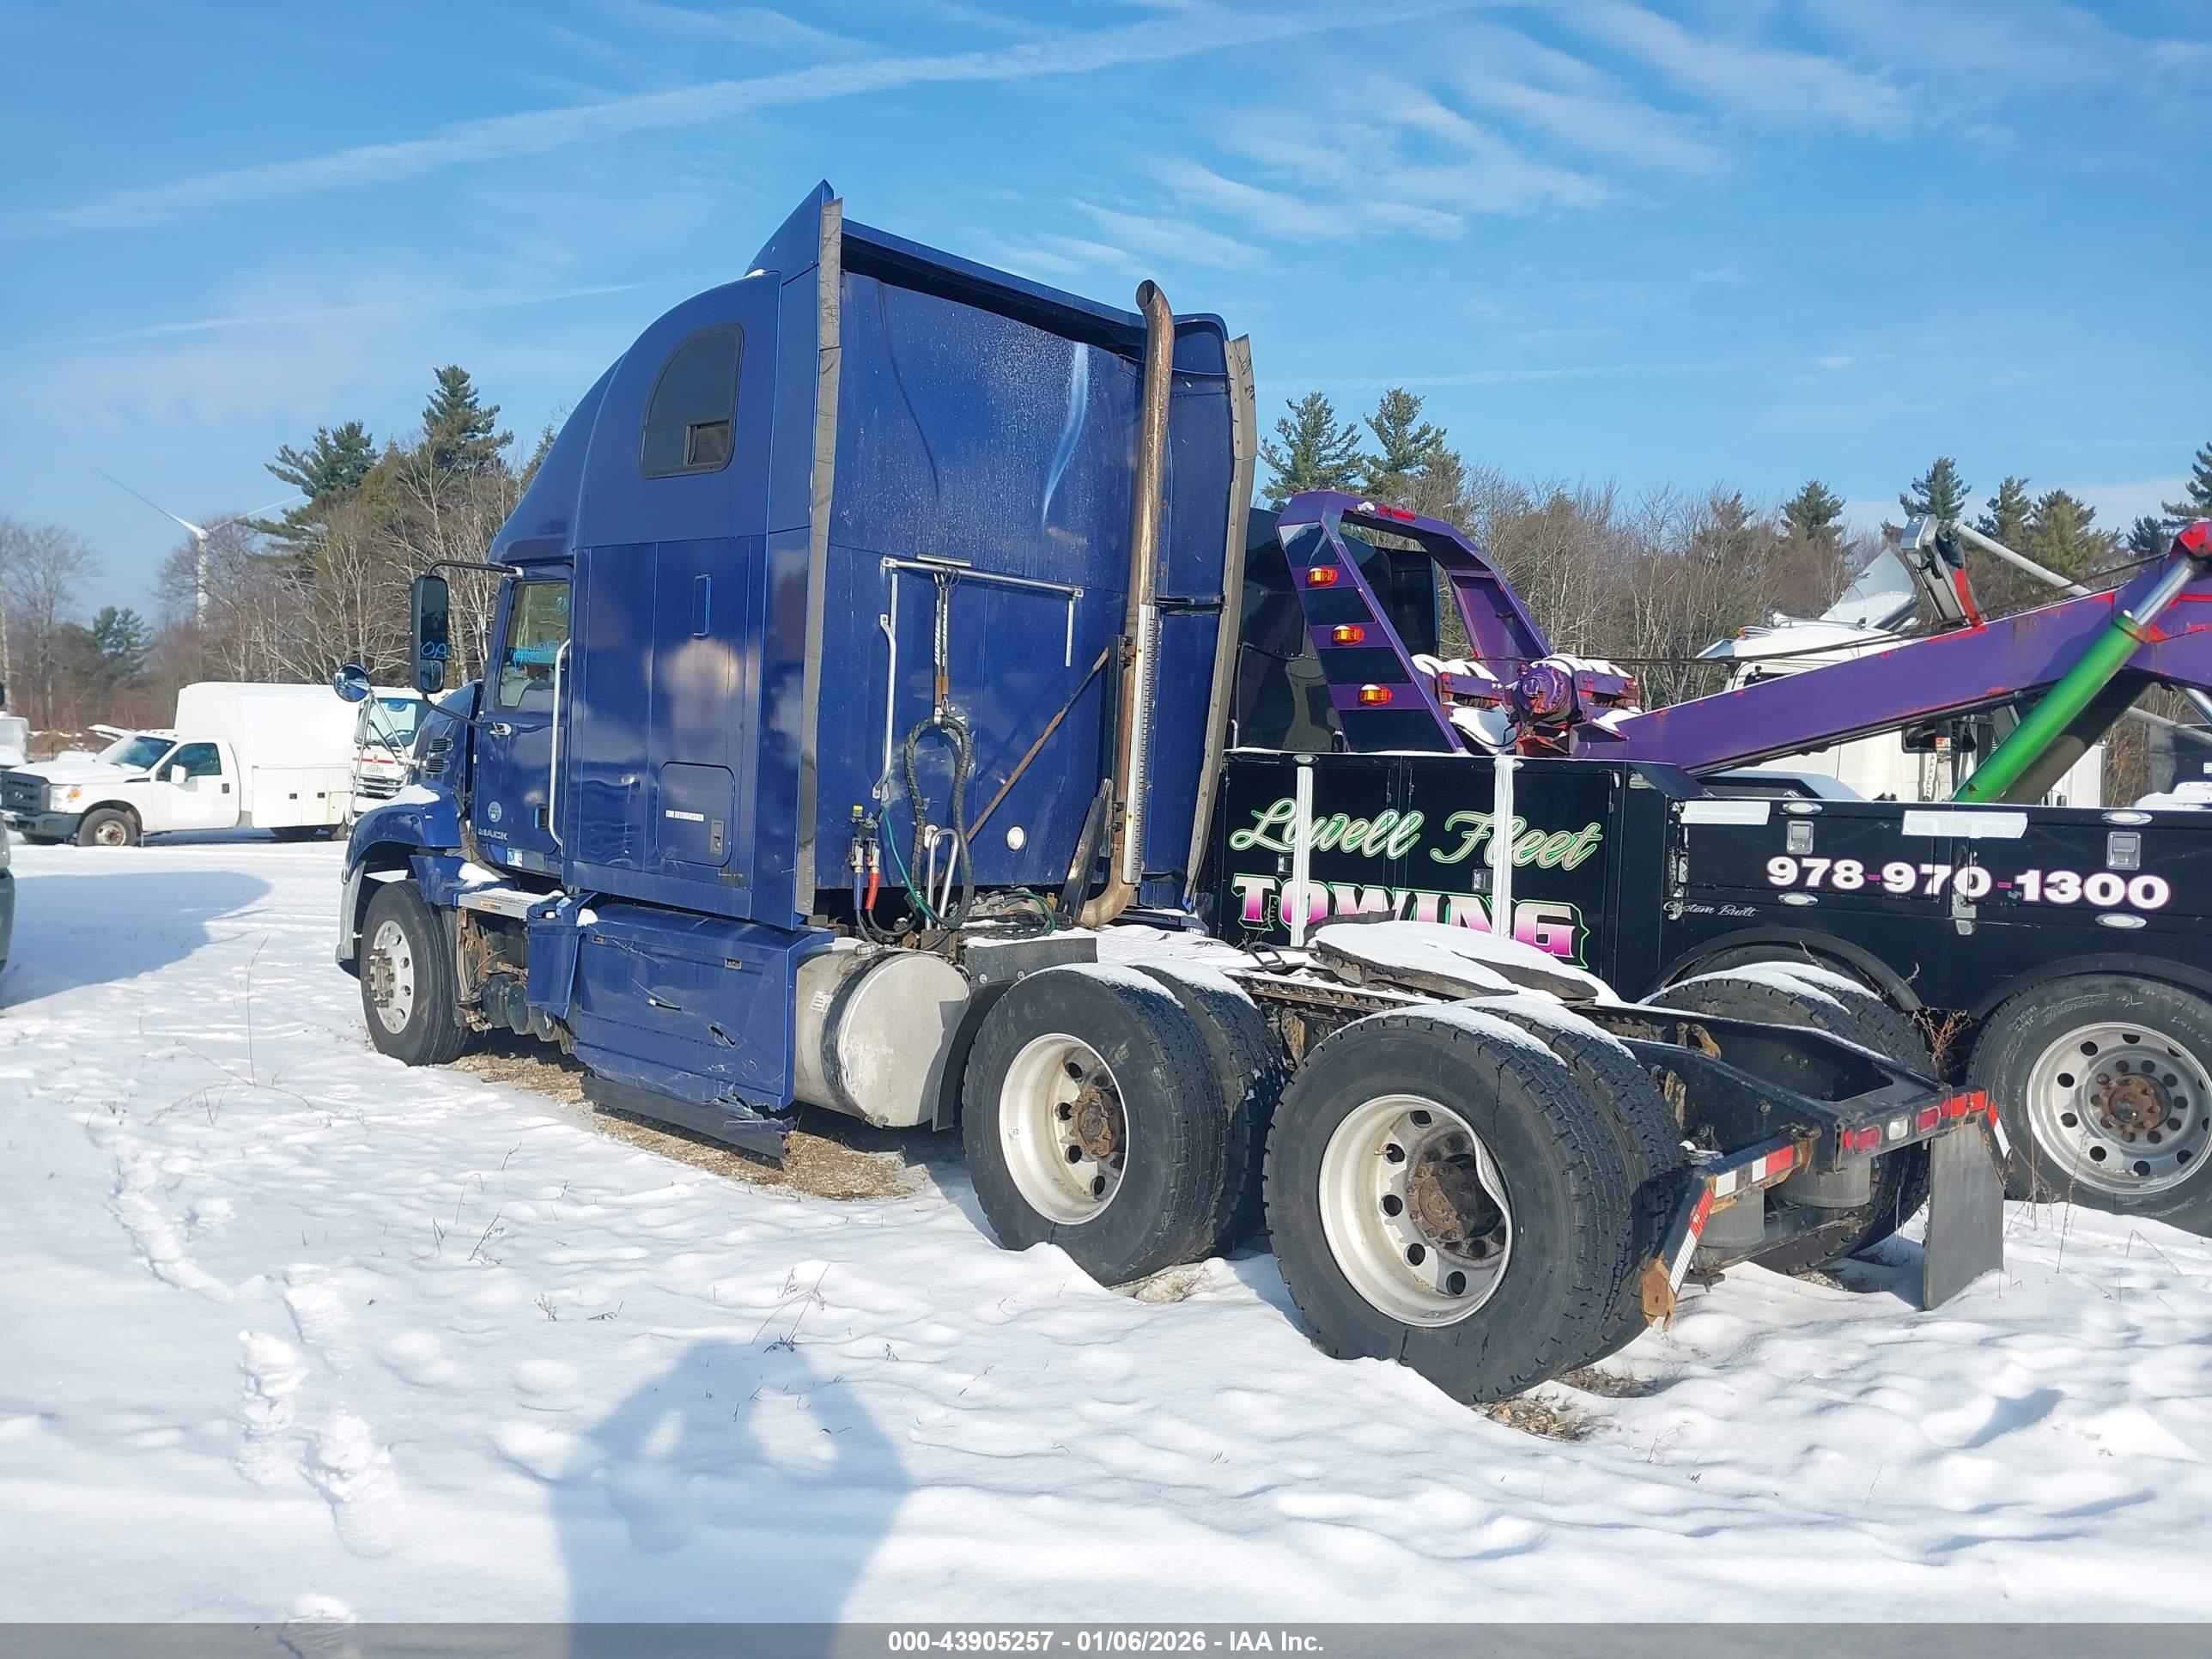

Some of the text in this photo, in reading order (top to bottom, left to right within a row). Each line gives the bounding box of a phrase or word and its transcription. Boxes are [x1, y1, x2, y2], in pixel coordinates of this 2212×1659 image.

[477, 828, 509, 841] MACK
[1229, 798, 1603, 872] Lowell Fleet
[1765, 854, 2172, 910] 978-970-1300
[1662, 900, 1762, 918] Cstom Built
